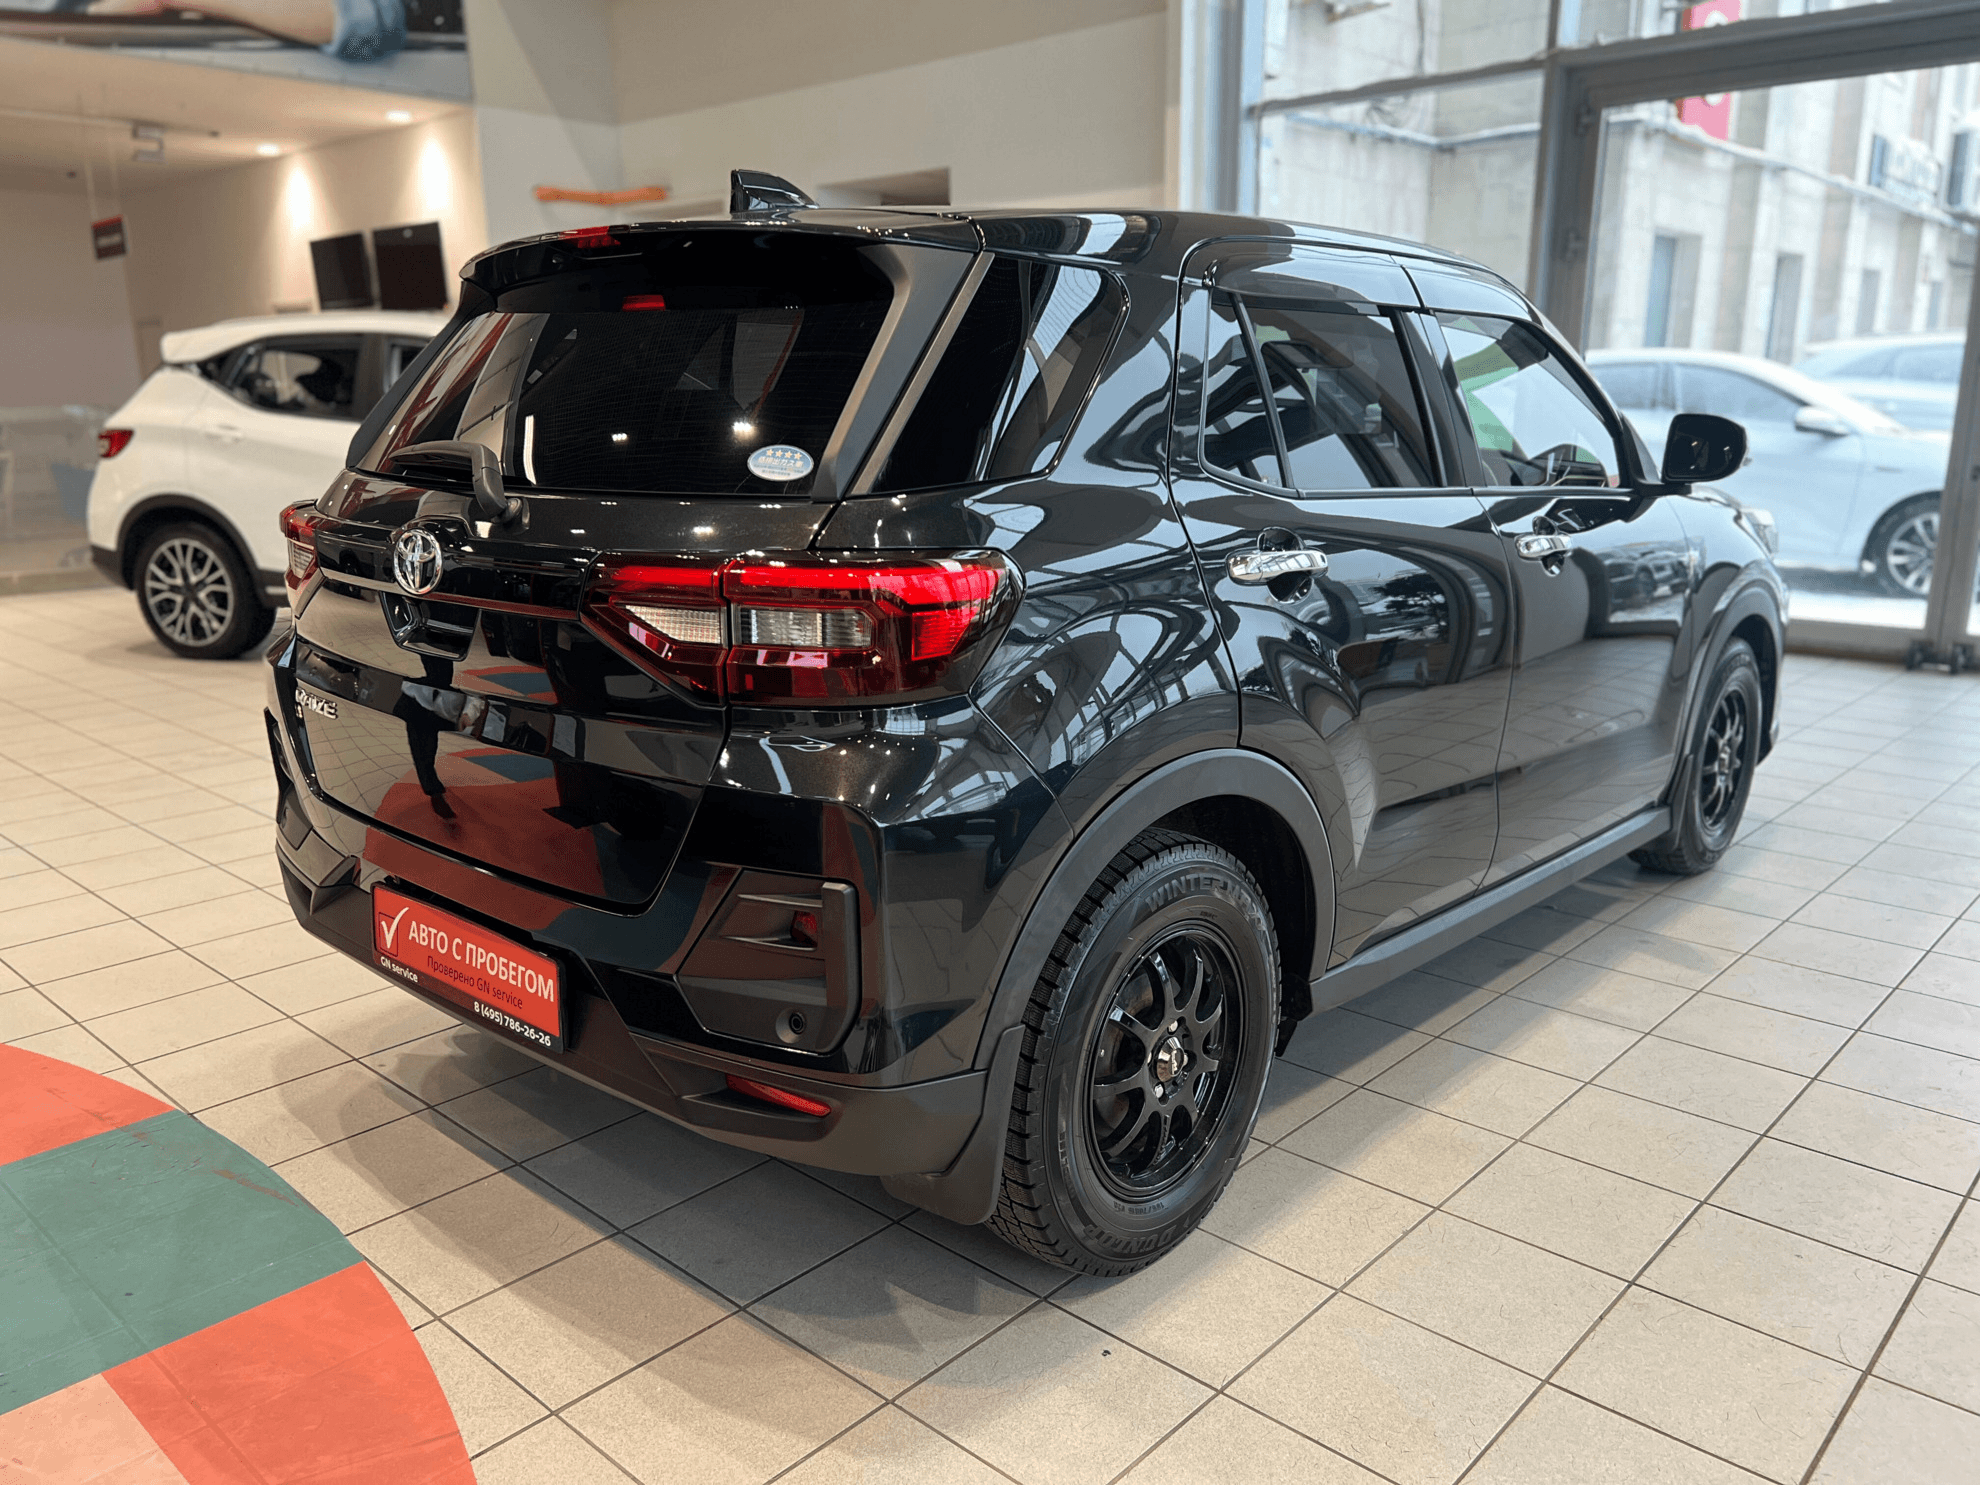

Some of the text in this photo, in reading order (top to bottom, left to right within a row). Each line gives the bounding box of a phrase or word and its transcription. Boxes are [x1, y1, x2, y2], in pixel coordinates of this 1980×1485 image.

[1145, 873, 1229, 912] WINTER
[380, 956, 419, 983] GN service
[409, 920, 555, 1002] АВТО С ПРОБЕГОМ
[427, 955, 523, 1009] Проверено GN service
[474, 1001, 551, 1047] 8 (495) 786-26-26
